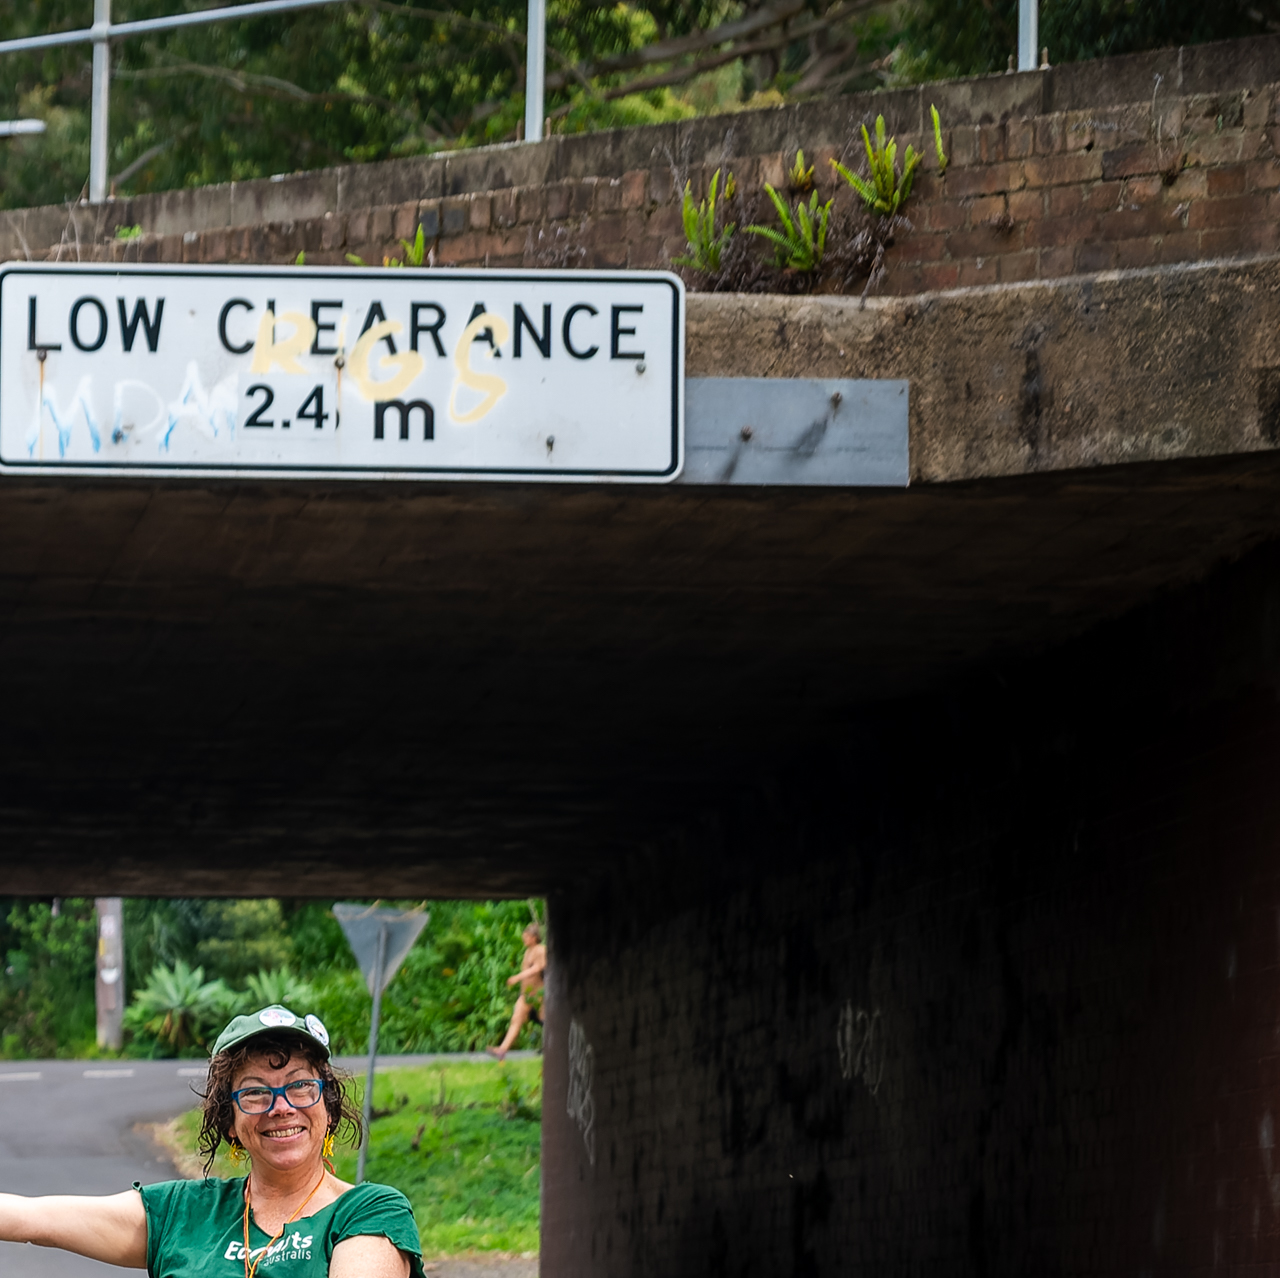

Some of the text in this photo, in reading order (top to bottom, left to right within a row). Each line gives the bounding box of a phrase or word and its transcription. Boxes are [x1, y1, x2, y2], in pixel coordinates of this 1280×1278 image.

[27, 295, 646, 361] LOW CLEARANCE
[243, 383, 435, 441] 2.4 m
